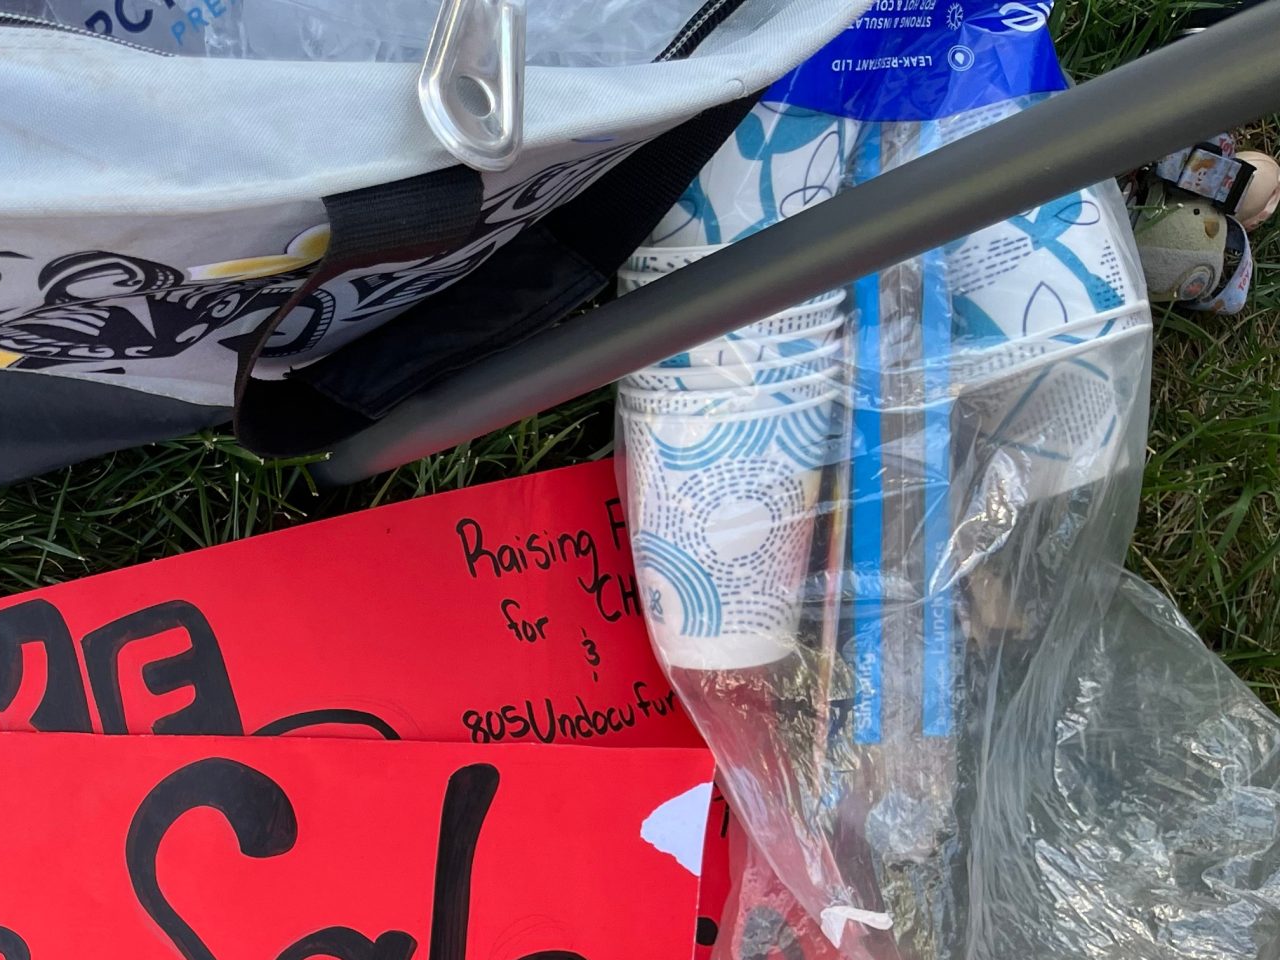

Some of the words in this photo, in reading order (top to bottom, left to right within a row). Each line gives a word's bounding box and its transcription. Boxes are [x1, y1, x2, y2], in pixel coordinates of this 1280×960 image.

[868, 0, 895, 11] COL
[847, 17, 892, 30] INSULAT
[899, 15, 932, 28] STRONG
[831, 59, 853, 71] LID
[855, 55, 933, 70] LEAK-RESISTANT
[455, 517, 598, 594] Raising
[605, 499, 626, 552] F
[500, 598, 550, 643] for
[595, 572, 641, 623] CH
[462, 703, 530, 743] 805
